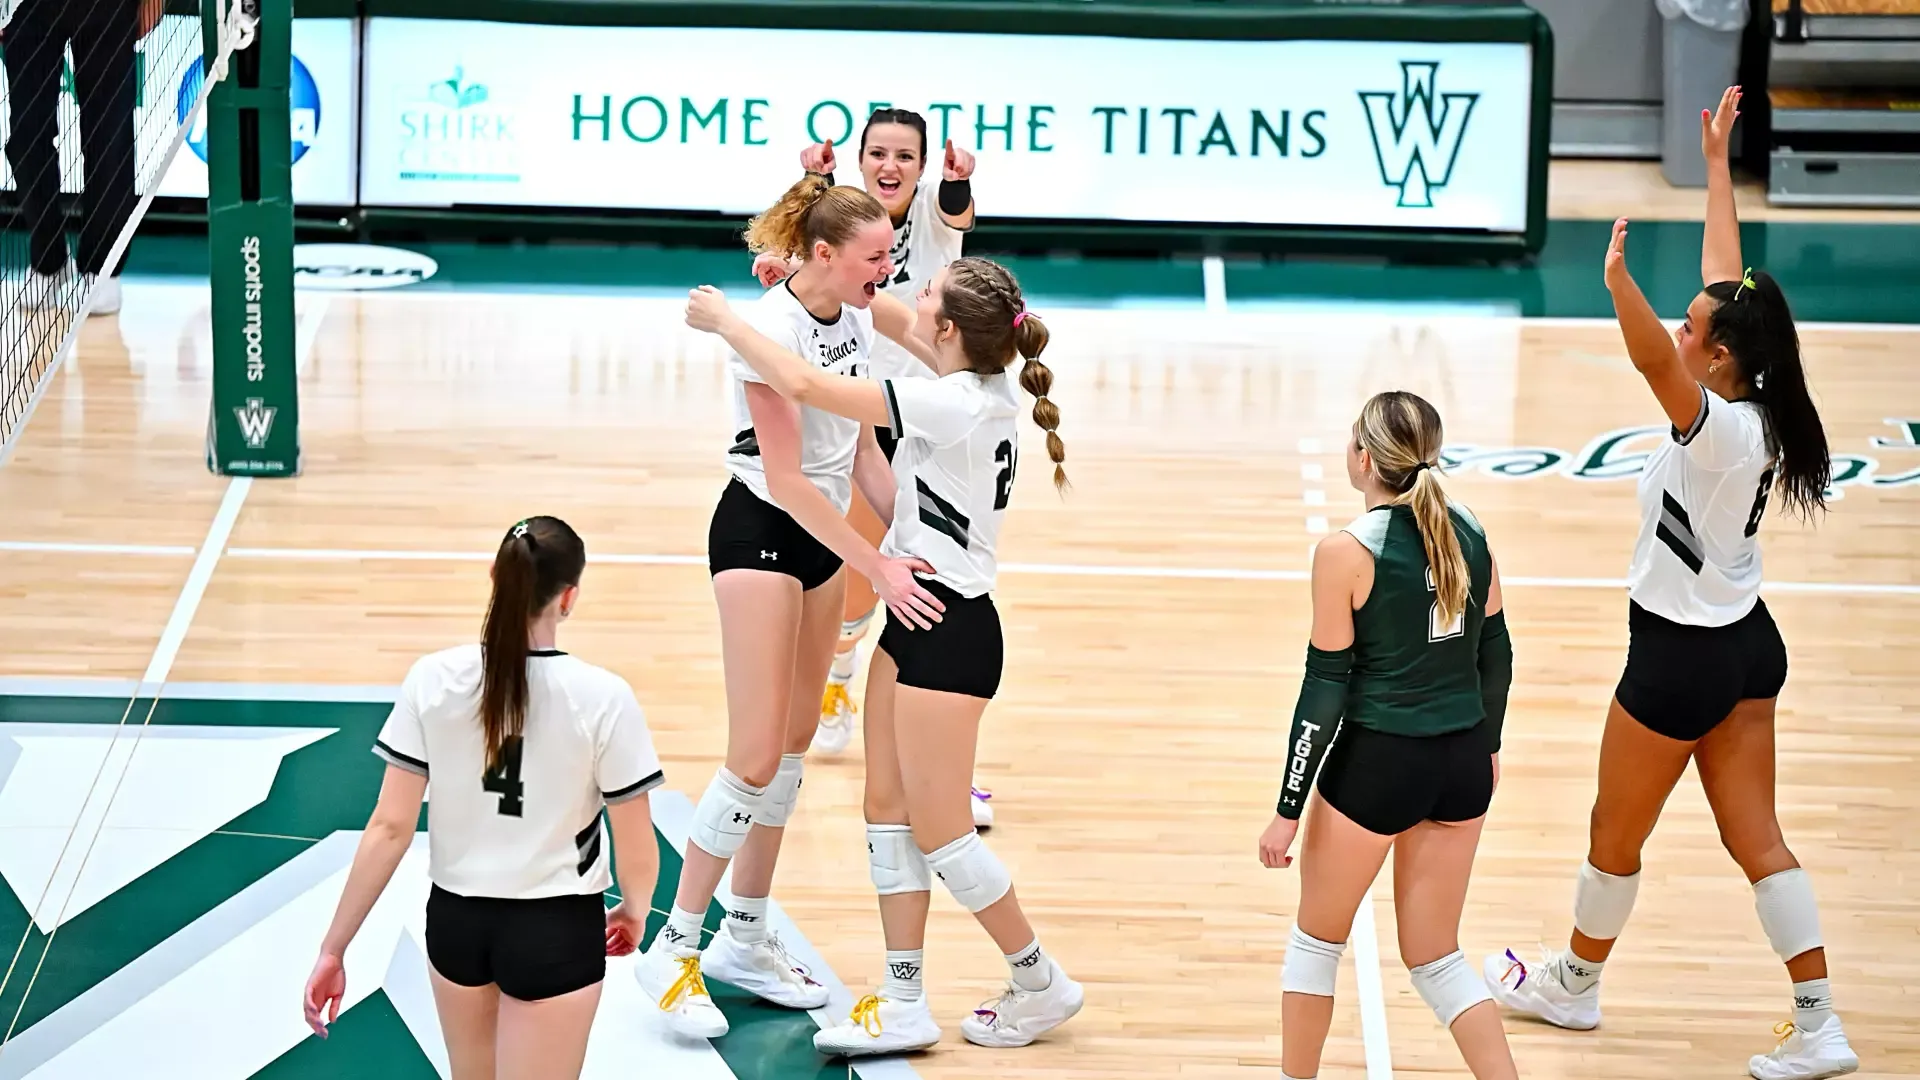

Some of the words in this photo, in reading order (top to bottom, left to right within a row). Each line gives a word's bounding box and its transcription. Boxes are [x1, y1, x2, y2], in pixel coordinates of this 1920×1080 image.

[400, 111, 516, 141] SHIRK
[572, 94, 770, 146] HOME
[928, 102, 1056, 153] THE
[1091, 106, 1327, 158] TITANS
[240, 235, 264, 301] sports
[242, 302, 266, 382] imports
[818, 336, 858, 368] Titans
[992, 437, 1018, 512] 2
[481, 733, 524, 818] 4
[1286, 719, 1321, 793] TGOE
